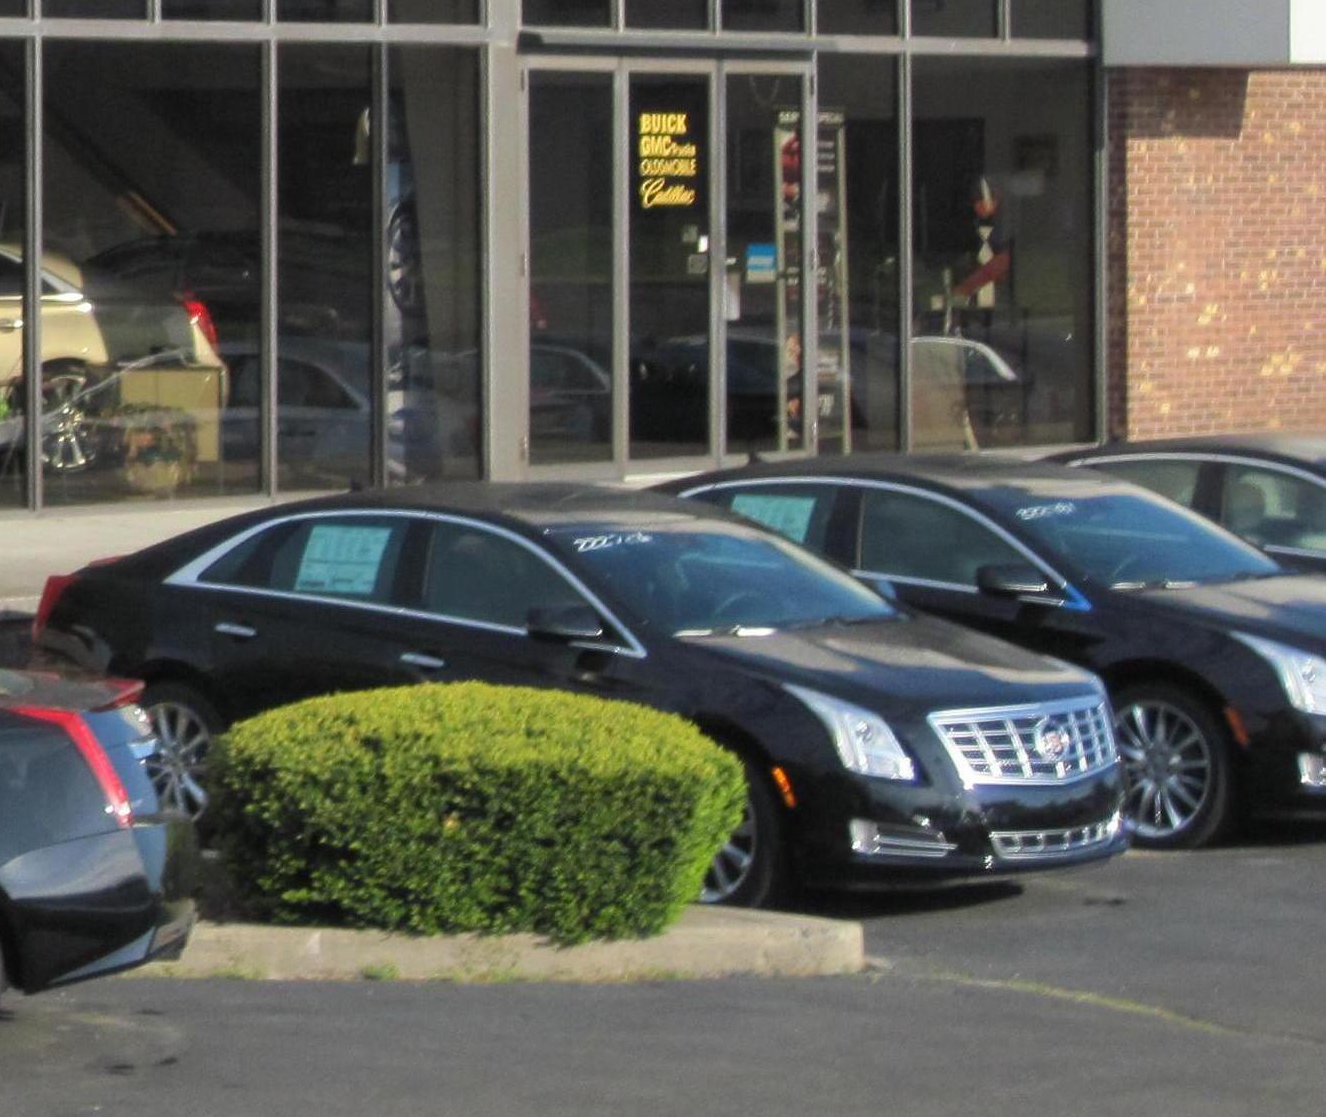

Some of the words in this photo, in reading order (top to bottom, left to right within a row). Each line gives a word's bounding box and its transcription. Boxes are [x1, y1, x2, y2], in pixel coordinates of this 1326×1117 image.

[640, 113, 687, 135] BUICK
[640, 135, 671, 157] GMC
[640, 158, 697, 176] OLDSMOBILE
[640, 178, 695, 208] Cadillac
